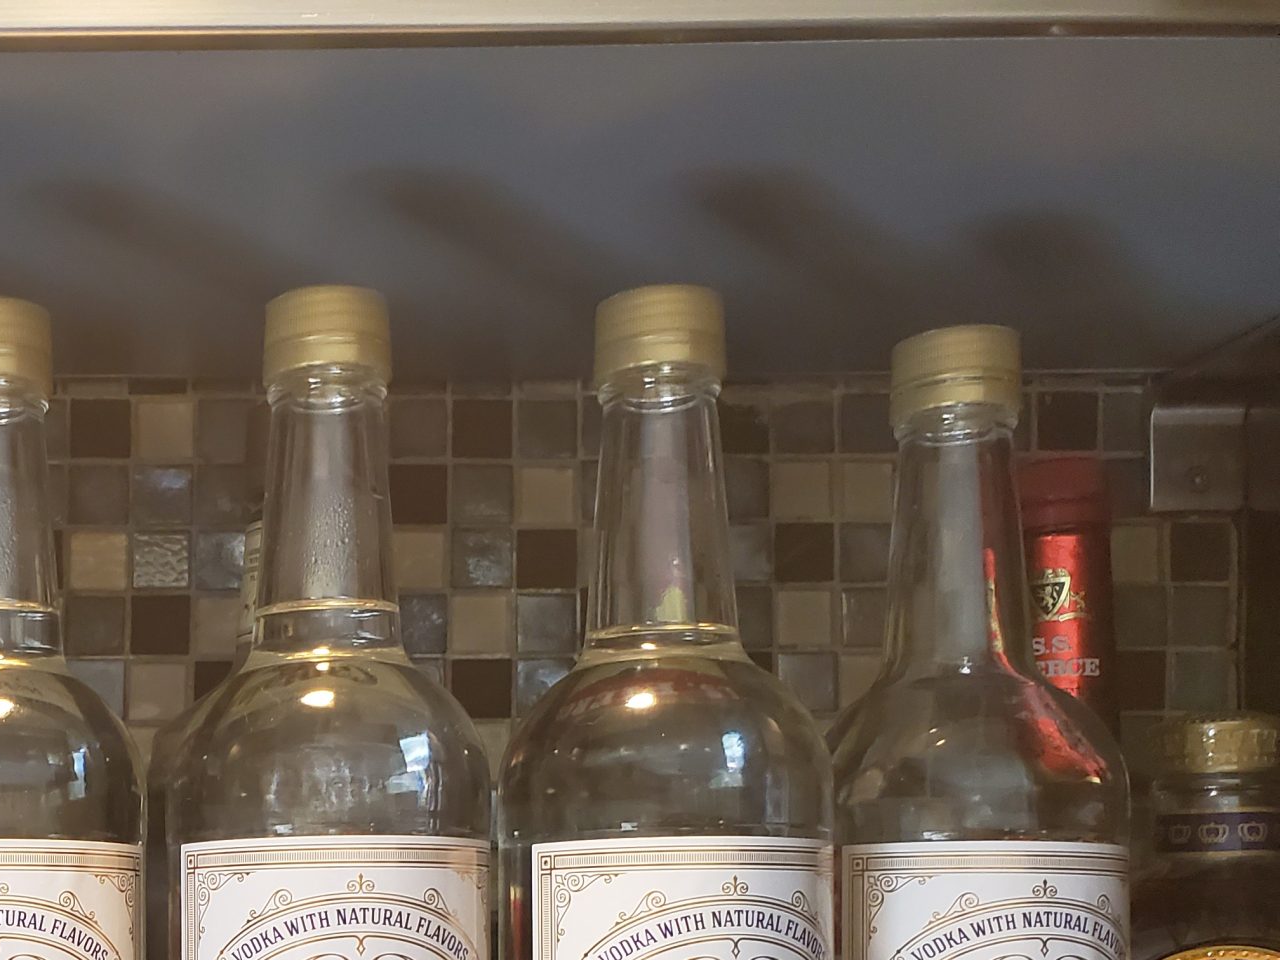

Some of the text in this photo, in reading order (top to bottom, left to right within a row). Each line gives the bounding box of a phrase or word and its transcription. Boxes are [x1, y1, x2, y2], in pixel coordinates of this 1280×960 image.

[284, 910, 331, 937] WITH
[336, 907, 413, 931] NATURAL
[656, 912, 705, 939] WITH
[711, 909, 782, 934] NATURAL
[969, 913, 1015, 938] WITH
[1022, 911, 1089, 934] NATURAL
